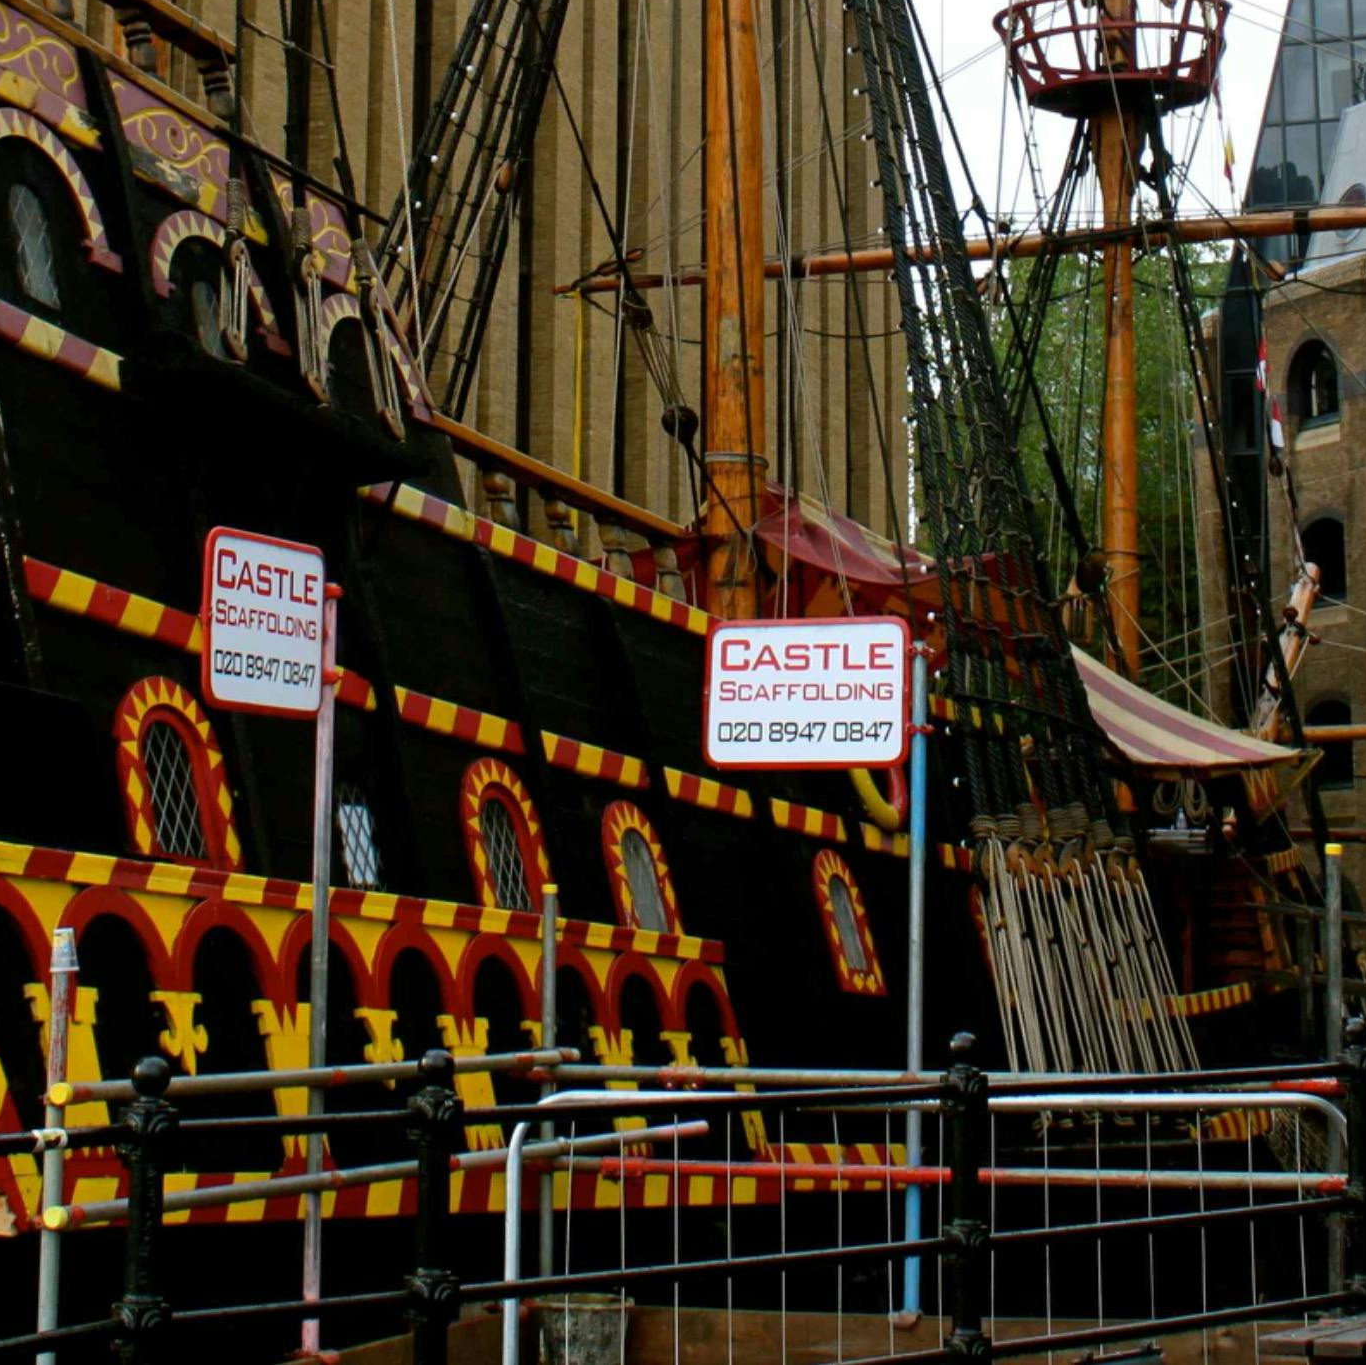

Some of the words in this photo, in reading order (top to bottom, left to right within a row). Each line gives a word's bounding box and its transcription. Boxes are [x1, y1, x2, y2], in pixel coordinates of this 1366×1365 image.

[216, 549, 318, 606] CASTLE
[215, 598, 317, 641] SCAFFOLDING
[214, 649, 243, 677] 020
[245, 654, 280, 682] 8947
[282, 660, 316, 688] 0847
[720, 638, 894, 671] CASTLE
[719, 680, 894, 702] SCAFFOLDING
[717, 722, 763, 742] 020
[768, 722, 826, 742] 8947
[833, 721, 894, 742] 0847
